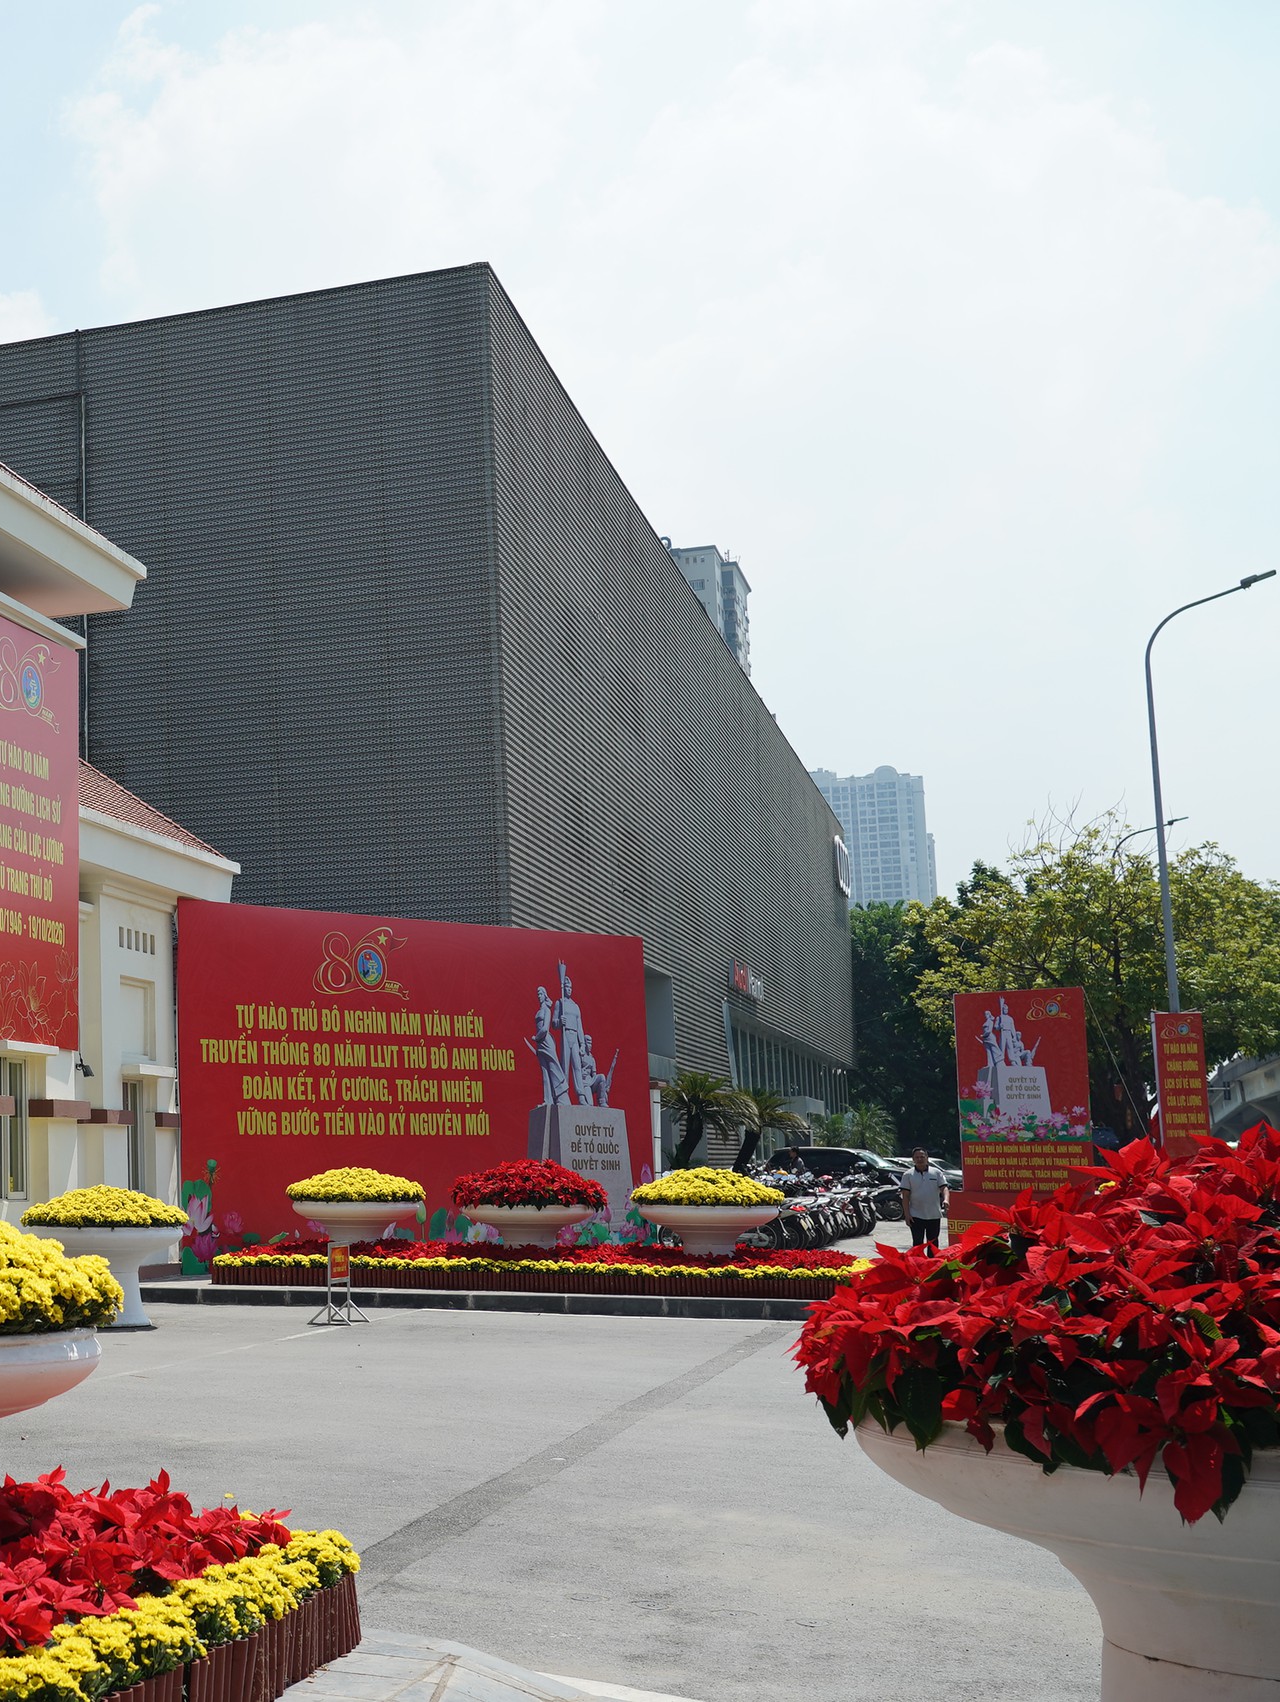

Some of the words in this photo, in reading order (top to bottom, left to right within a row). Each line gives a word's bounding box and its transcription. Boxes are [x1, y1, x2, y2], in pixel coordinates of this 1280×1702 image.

[8, 741, 22, 770] HÀO
[24, 750, 32, 774] 80
[34, 751, 49, 780] NĂM
[11, 784, 34, 816] ĐƯỜNG
[36, 795, 50, 823] LỊCH
[52, 794, 61, 824] SỬ
[14, 821, 27, 854] CỦA
[29, 832, 41, 862] LỰC
[43, 837, 63, 868] LƯỢNG
[7, 867, 28, 896] TRANG
[30, 868, 42, 900] THỦ
[44, 874, 52, 902] ĐÔ
[28, 915, 65, 948] 19/10/2026)
[236, 1003, 255, 1034] TỰ
[258, 1002, 287, 1030] HÀO
[291, 1001, 318, 1031] THỦ
[322, 1005, 341, 1032] ĐÔ
[345, 1007, 387, 1034] NGHÌN
[391, 1008, 422, 1035] NĂM
[424, 1010, 451, 1037] VĂN
[454, 1009, 484, 1038] HIẾN
[200, 1033, 258, 1064] TRUYỀN
[262, 1034, 309, 1065] THỐNG
[314, 1043, 330, 1066] 80
[334, 1039, 366, 1067] NĂM
[370, 1045, 398, 1068] LLVT
[402, 1039, 427, 1069] THỦ
[431, 1043, 448, 1069] ĐÔ
[452, 1048, 478, 1070] ANH
[481, 1044, 515, 1071] HÙNG
[243, 1071, 283, 1100] ĐOÀN
[288, 1069, 315, 1103] KẾT,
[320, 1070, 337, 1100] KỶ
[342, 1076, 392, 1104] CƯƠNG,
[396, 1075, 438, 1102] TRÁCH
[442, 1076, 483, 1107] NHIỆM
[237, 1107, 276, 1135] VỮNG
[281, 1107, 319, 1135] BƯỚC
[324, 1105, 354, 1135] TIẾN
[358, 1108, 385, 1135] VÀO
[389, 1105, 405, 1135] KỶ
[410, 1109, 461, 1135] NGUYÊN
[465, 1109, 490, 1135] MỚI
[601, 1160, 620, 1170] SINH
